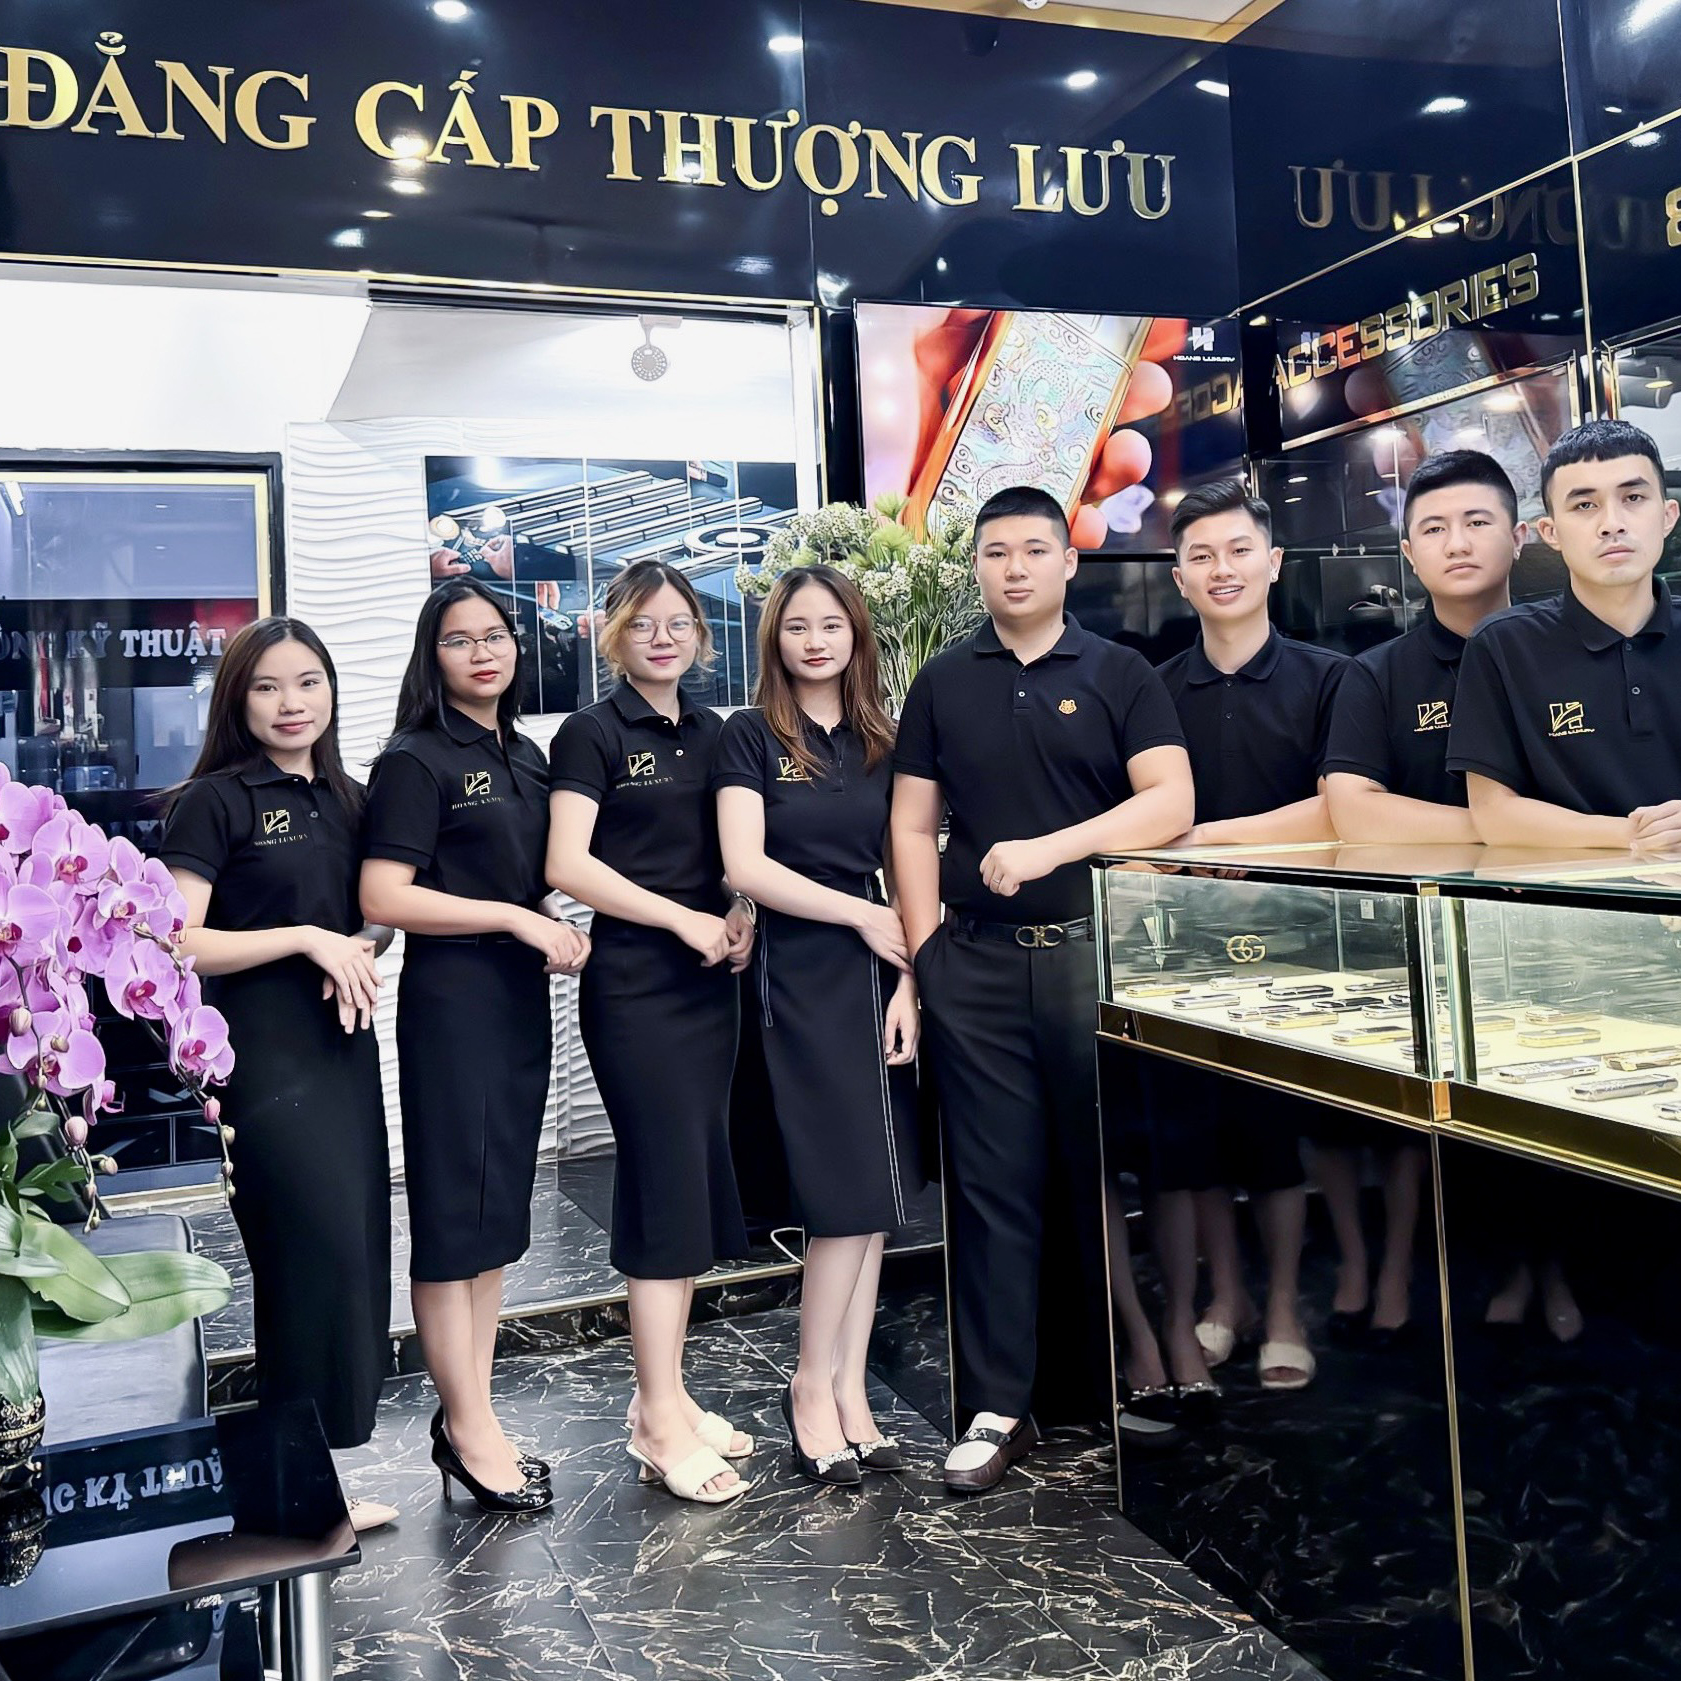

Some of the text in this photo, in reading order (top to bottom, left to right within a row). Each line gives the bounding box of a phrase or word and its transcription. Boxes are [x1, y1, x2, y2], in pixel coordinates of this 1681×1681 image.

[0, 31, 1175, 220] ĐẲNG CẤP THƯỢNG LƯU
[1272, 252, 1539, 391] ACCESSORIES
[119, 620, 227, 665] THUẬT
